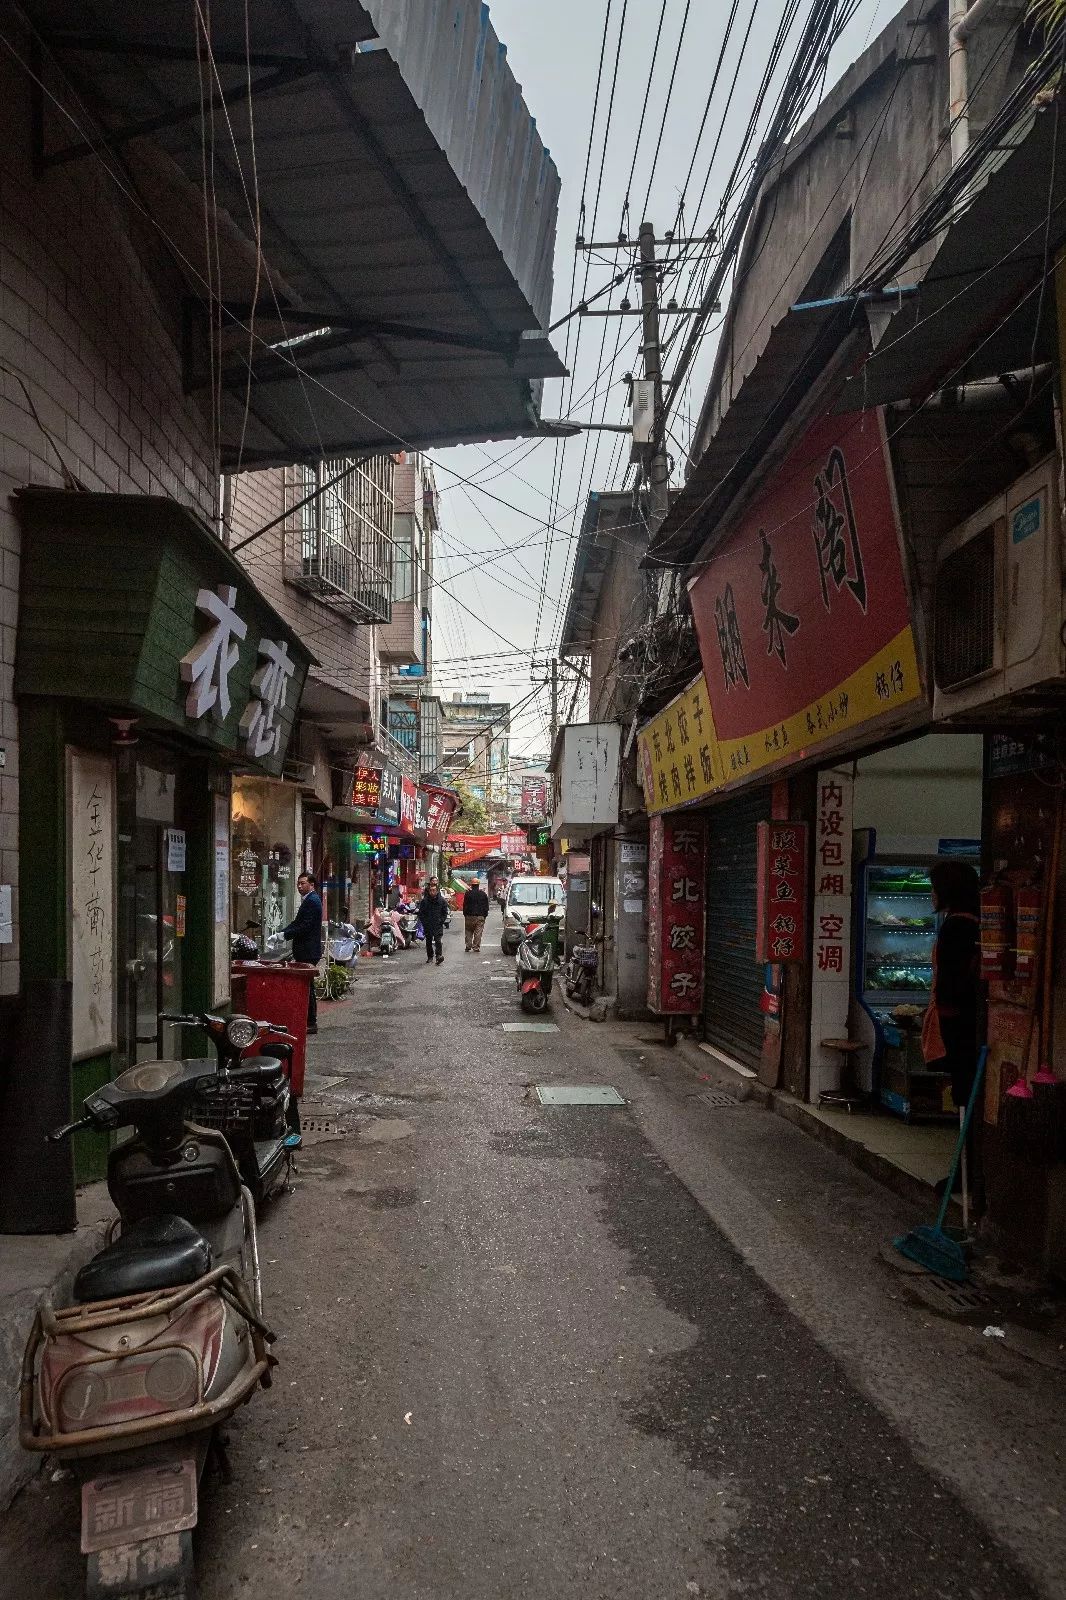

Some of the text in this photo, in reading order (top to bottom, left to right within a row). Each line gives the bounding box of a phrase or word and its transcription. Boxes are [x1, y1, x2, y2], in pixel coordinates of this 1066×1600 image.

[180, 584, 296, 758] 衣恋
[806, 693, 849, 735] 各式小炒
[875, 660, 905, 701] 锅仔
[653, 694, 704, 761] 东北饺子
[355, 782, 379, 793] 彩妆
[356, 769, 379, 781] 伊人
[658, 743, 714, 804] 烤肉拌饭
[816, 781, 845, 973] 内设包厢 空调
[670, 830, 701, 997] 东北饺子
